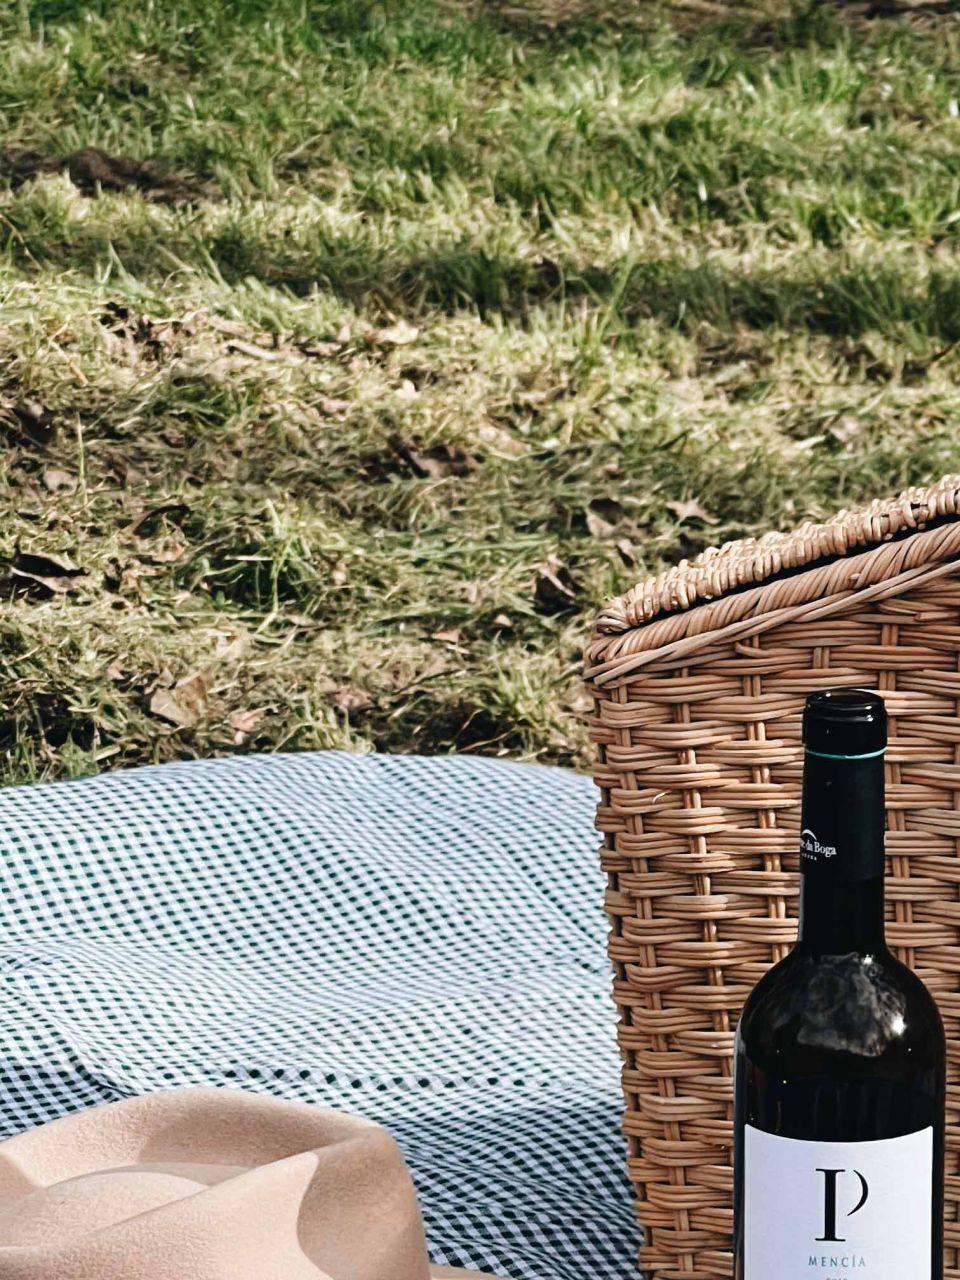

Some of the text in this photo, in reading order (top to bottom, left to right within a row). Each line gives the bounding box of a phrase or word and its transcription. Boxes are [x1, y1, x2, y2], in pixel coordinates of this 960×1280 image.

[814, 841, 837, 858] Boga
[814, 1167, 869, 1242] P
[808, 1254, 866, 1268] MENCÍA
